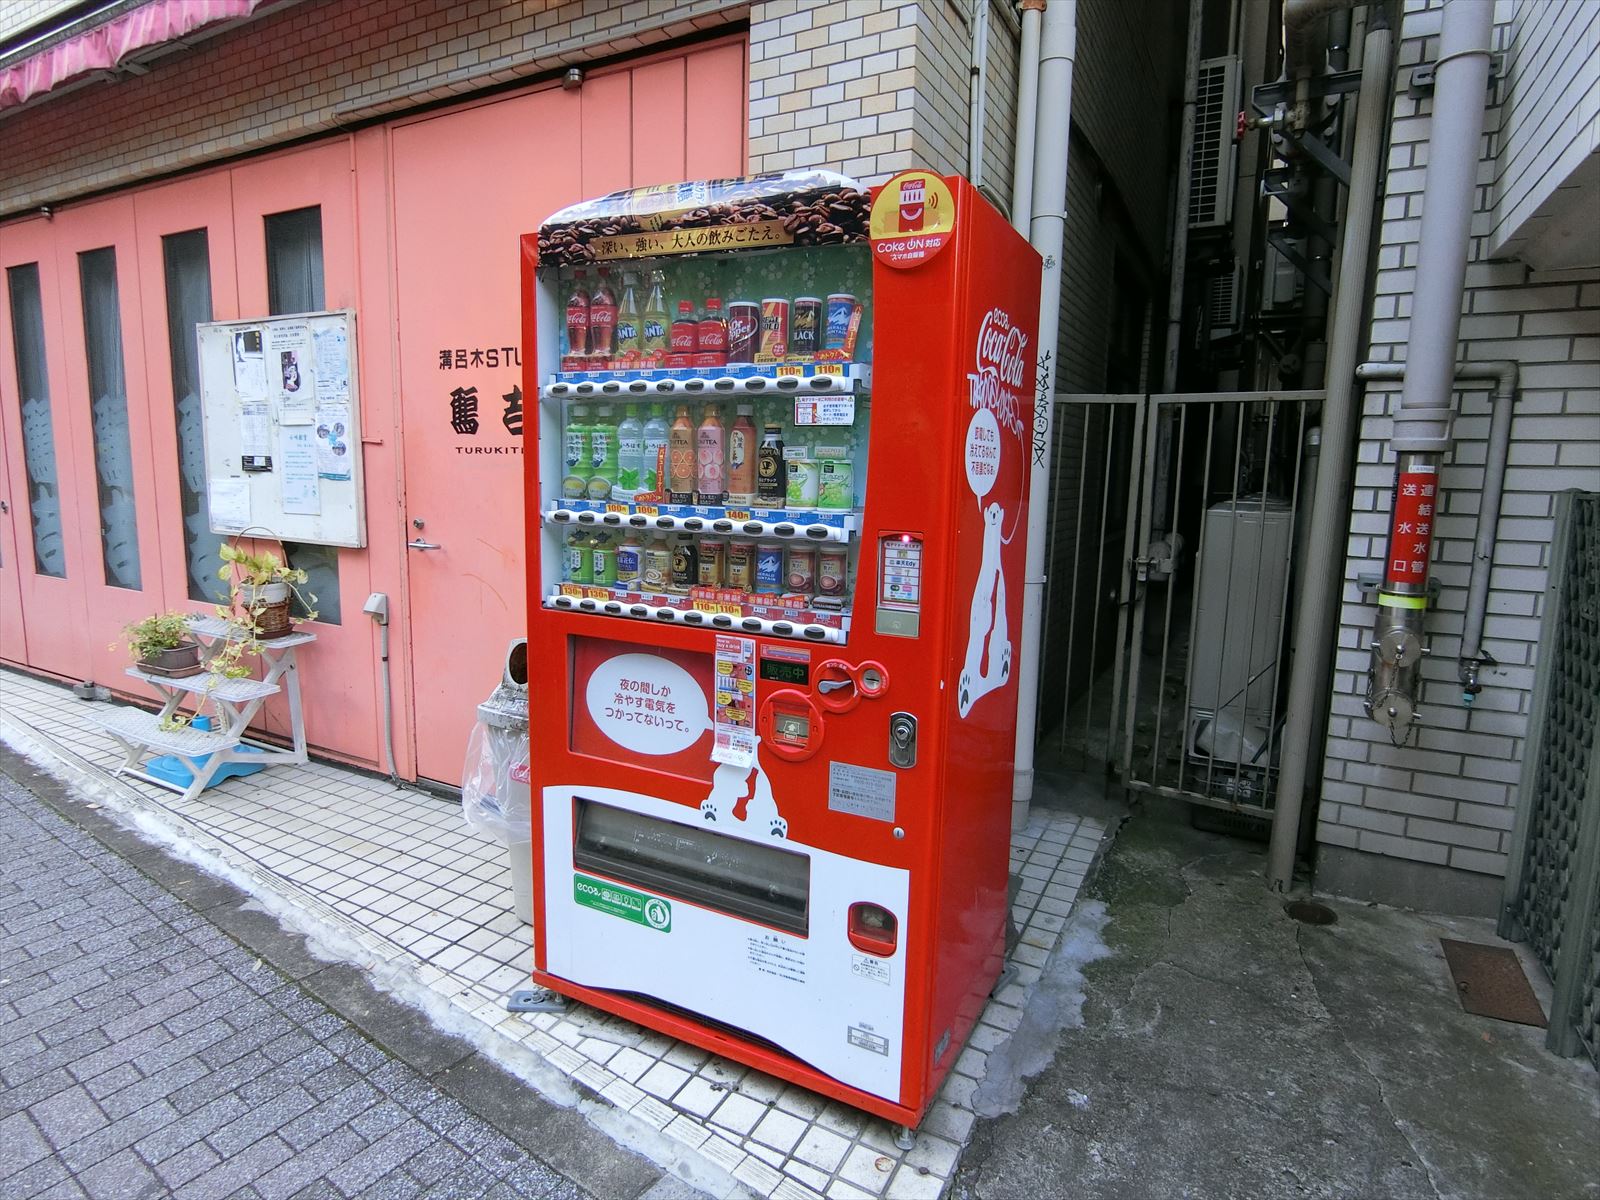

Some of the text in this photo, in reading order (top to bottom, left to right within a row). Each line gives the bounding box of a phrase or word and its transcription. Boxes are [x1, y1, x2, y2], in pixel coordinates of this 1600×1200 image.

[601, 226, 781, 256] 深い、強い、大人の飲みごたえ。
[877, 241, 905, 253] Coke
[925, 238, 941, 248] 対応
[793, 330, 814, 341] LACK
[779, 366, 801, 377] 110円
[817, 364, 841, 375] 110円
[607, 504, 627, 513] 100円
[637, 506, 657, 516] 100円
[726, 510, 749, 520] 140円
[564, 587, 582, 597] 130円
[589, 589, 608, 600] 130円
[695, 602, 715, 613] 110円
[719, 604, 739, 615] 110円
[620, 678, 671, 697] 夜の間しか
[613, 692, 676, 714] 冷やす電気を
[605, 707, 690, 733] つかってないって。
